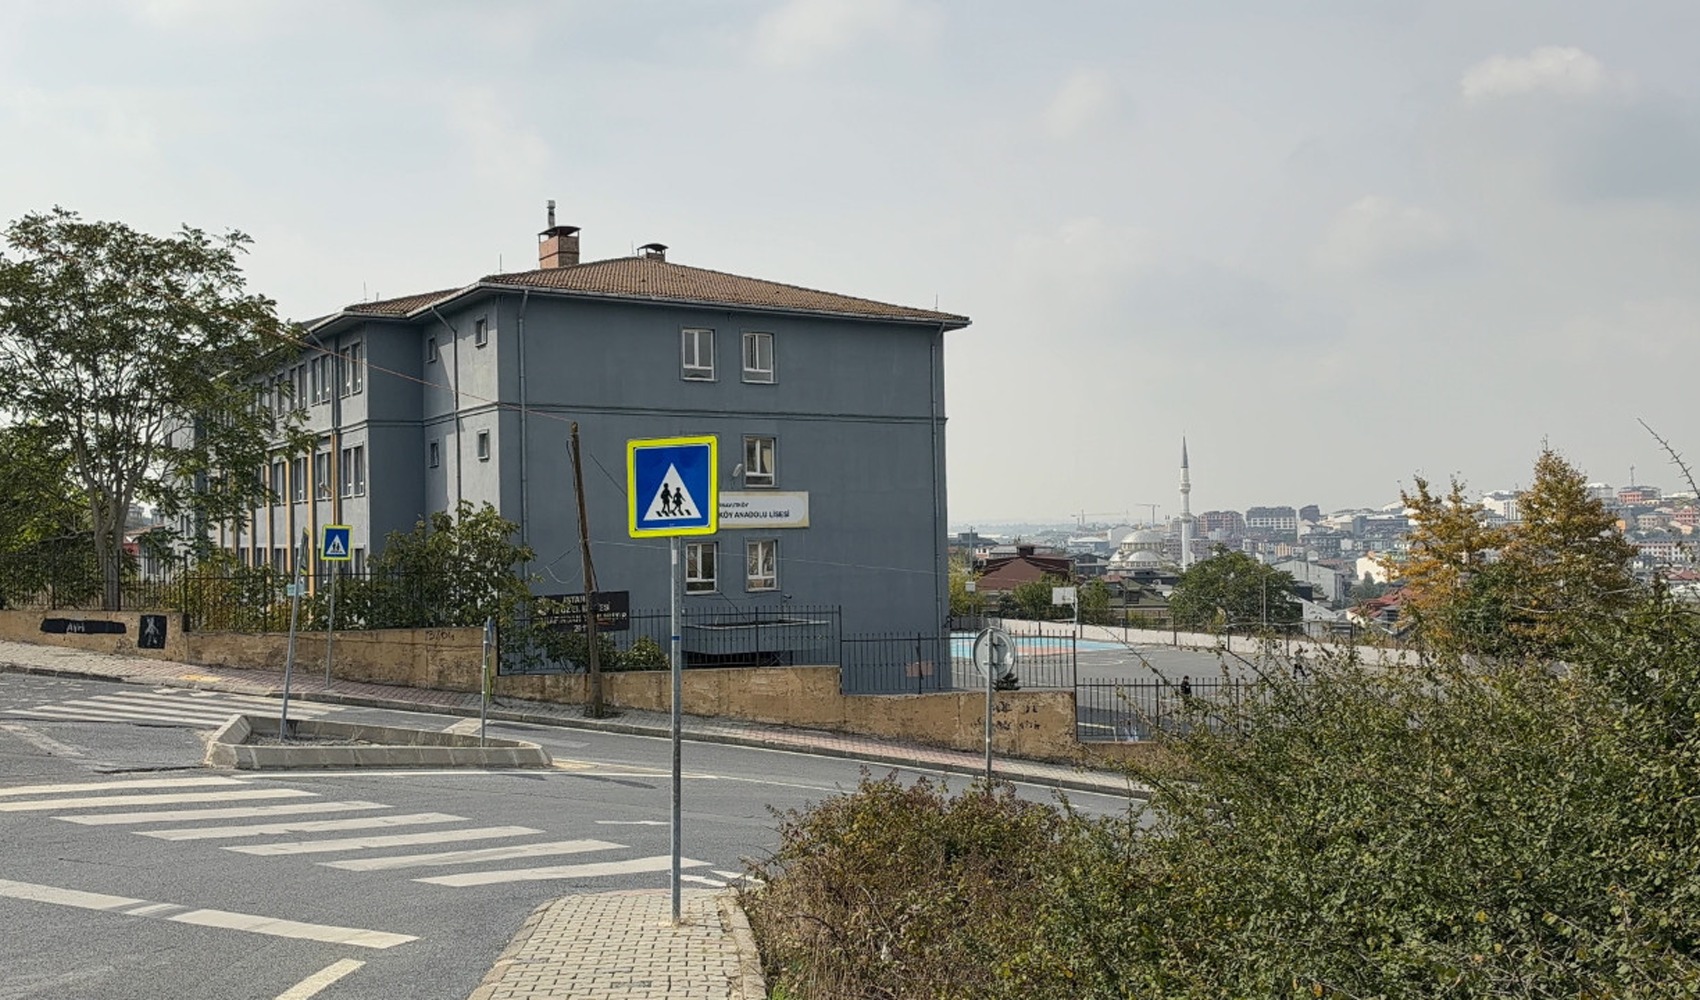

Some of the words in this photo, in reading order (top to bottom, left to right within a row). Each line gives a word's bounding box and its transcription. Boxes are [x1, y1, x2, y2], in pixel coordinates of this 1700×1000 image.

[718, 510, 733, 518] KÖY
[734, 510, 767, 518] ANADOLU
[769, 509, 790, 518] LİSESİ
